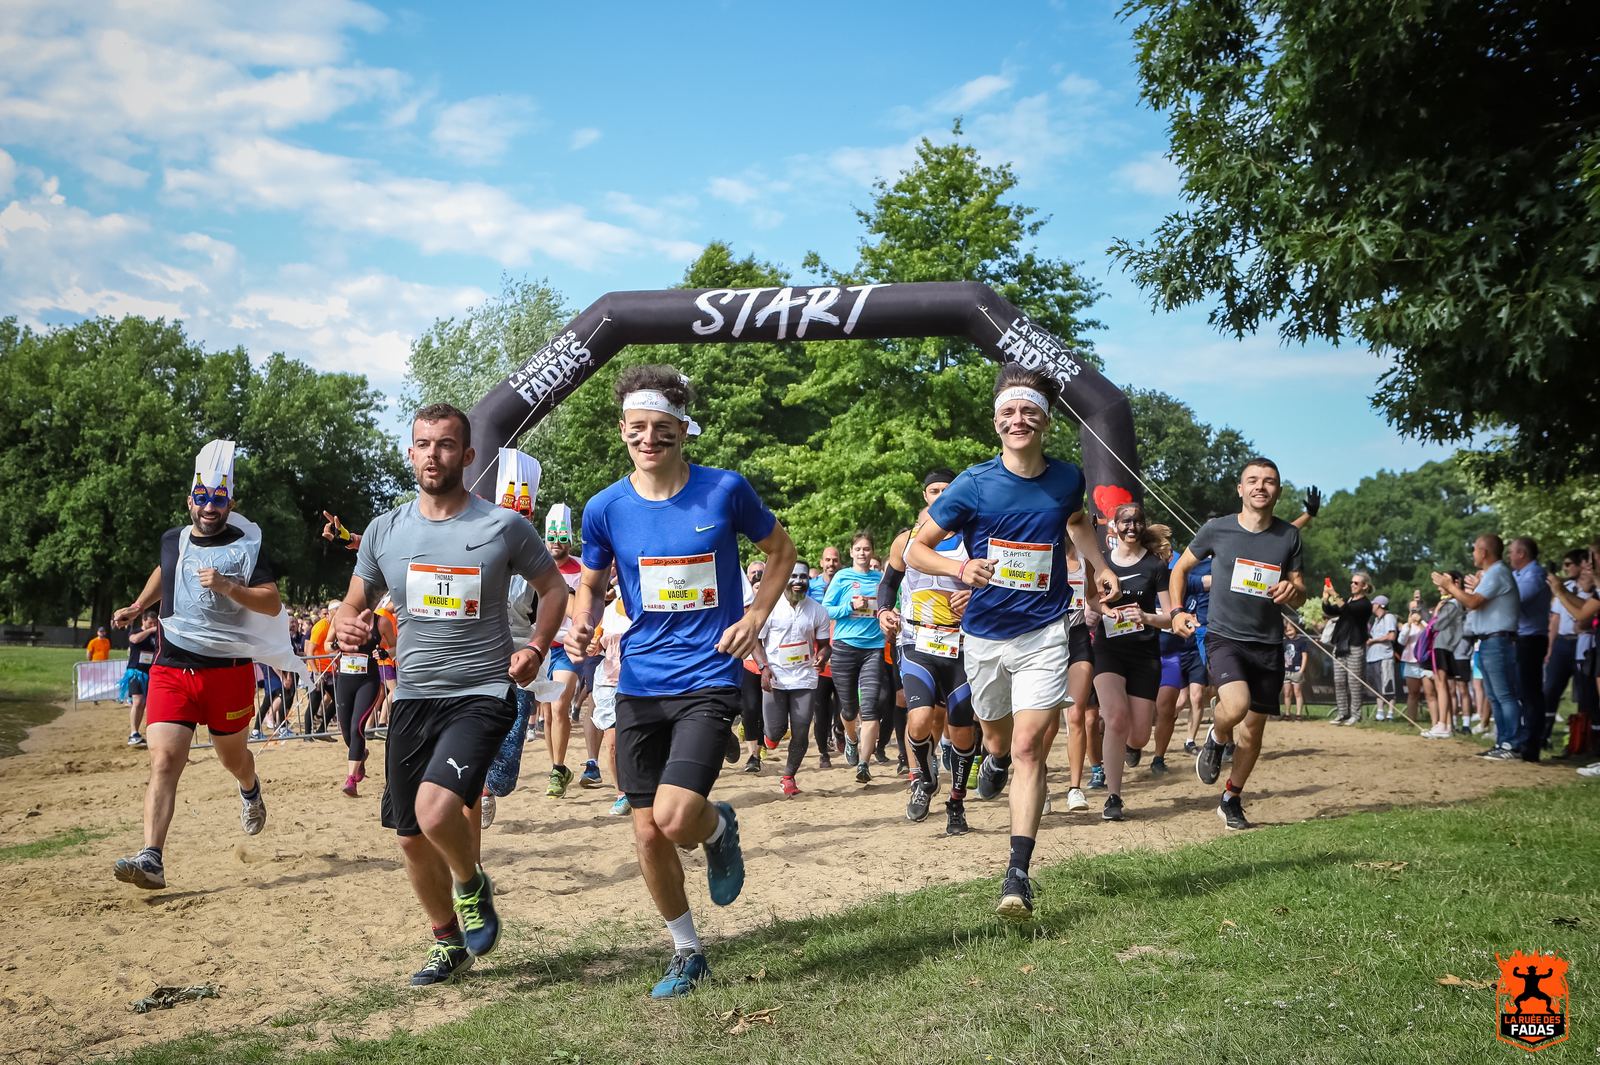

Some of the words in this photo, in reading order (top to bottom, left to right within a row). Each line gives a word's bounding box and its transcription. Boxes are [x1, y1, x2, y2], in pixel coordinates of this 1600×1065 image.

[692, 284, 891, 340] START
[1011, 318, 1029, 336] LA
[1060, 352, 1082, 376] DES
[508, 370, 527, 388] LA
[552, 330, 576, 352] DES
[516, 341, 591, 406] FADAS
[1004, 560, 1024, 568] 160
[434, 574, 454, 582] THOMAS
[1008, 570, 1026, 578] VAGUE
[1254, 572, 1262, 581] 10
[437, 582, 450, 596] 11
[668, 590, 688, 598] VAGUE
[428, 596, 448, 606] VAGUE
[934, 635, 944, 643] 32
